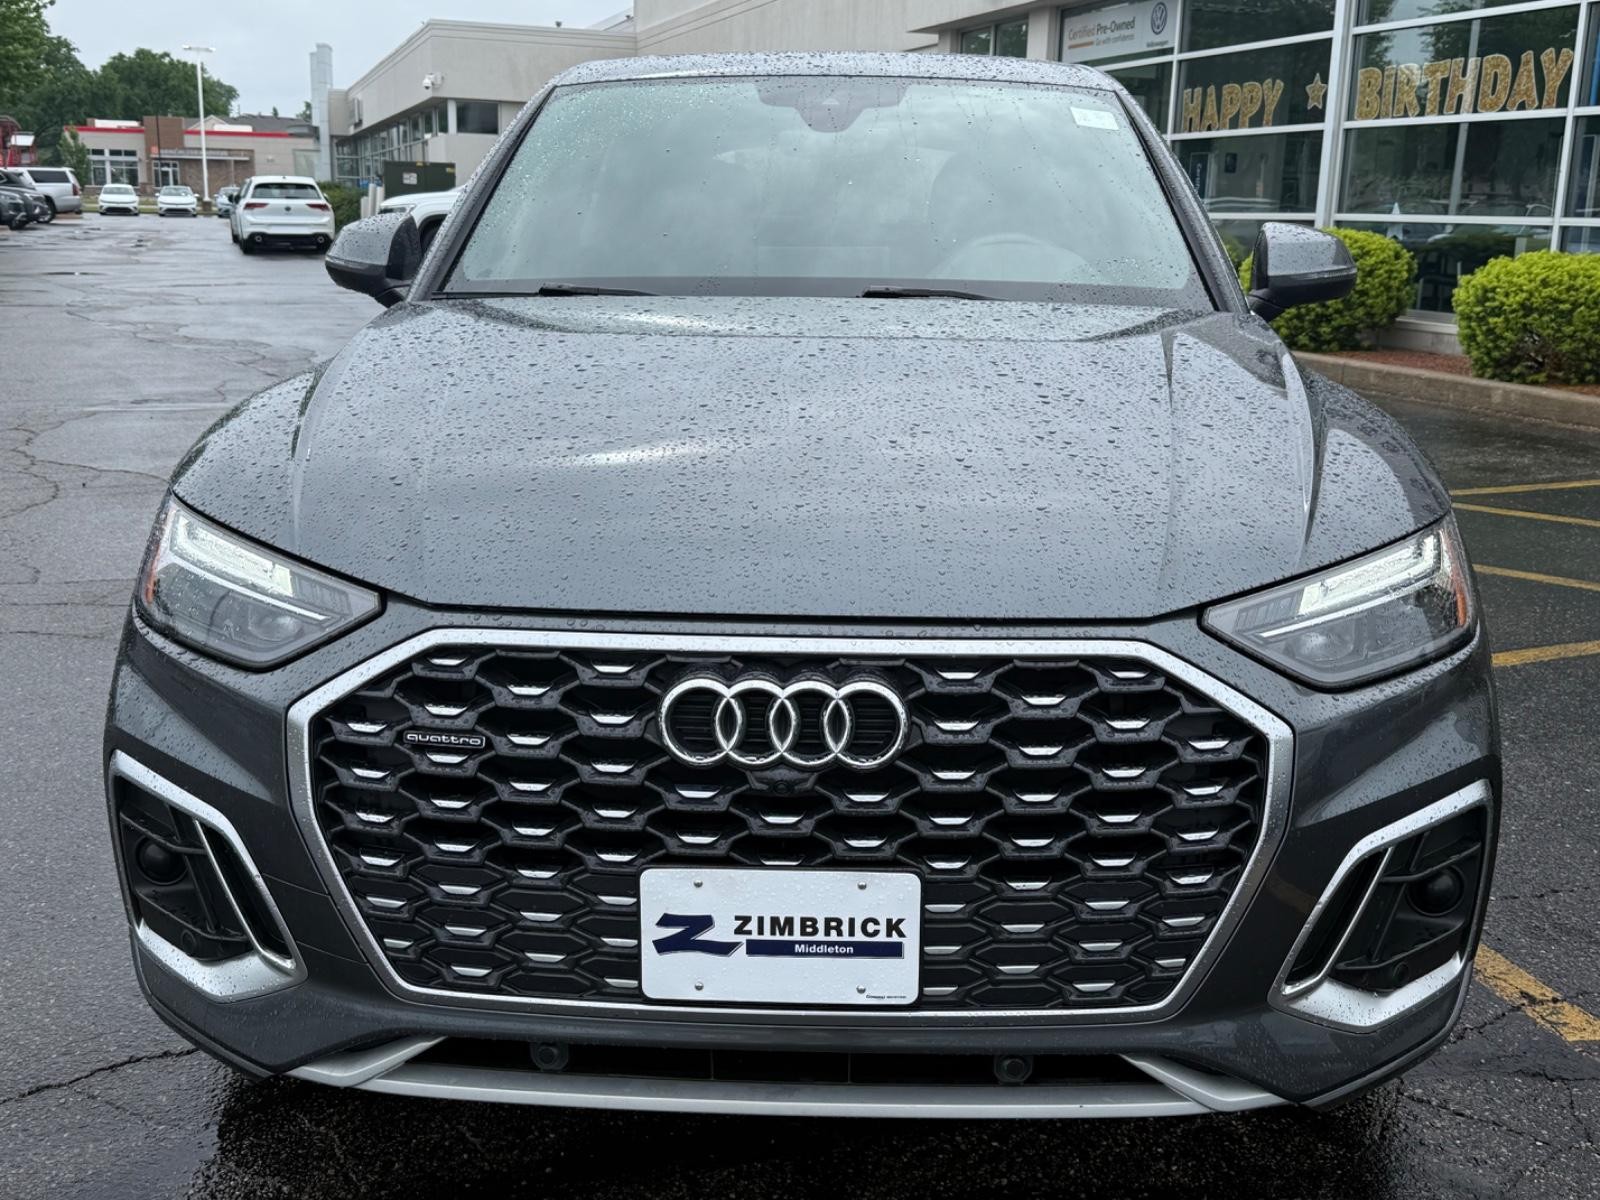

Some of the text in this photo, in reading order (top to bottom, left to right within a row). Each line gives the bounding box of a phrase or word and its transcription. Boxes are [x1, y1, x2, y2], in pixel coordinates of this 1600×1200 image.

[1068, 16, 1136, 41] Certified Pre-Owned
[1182, 48, 1574, 132] HAPPY BIRTHDAY
[406, 733, 481, 745] quattro
[733, 915, 907, 938] ZIMBRICK
[794, 943, 854, 954] Middleton
